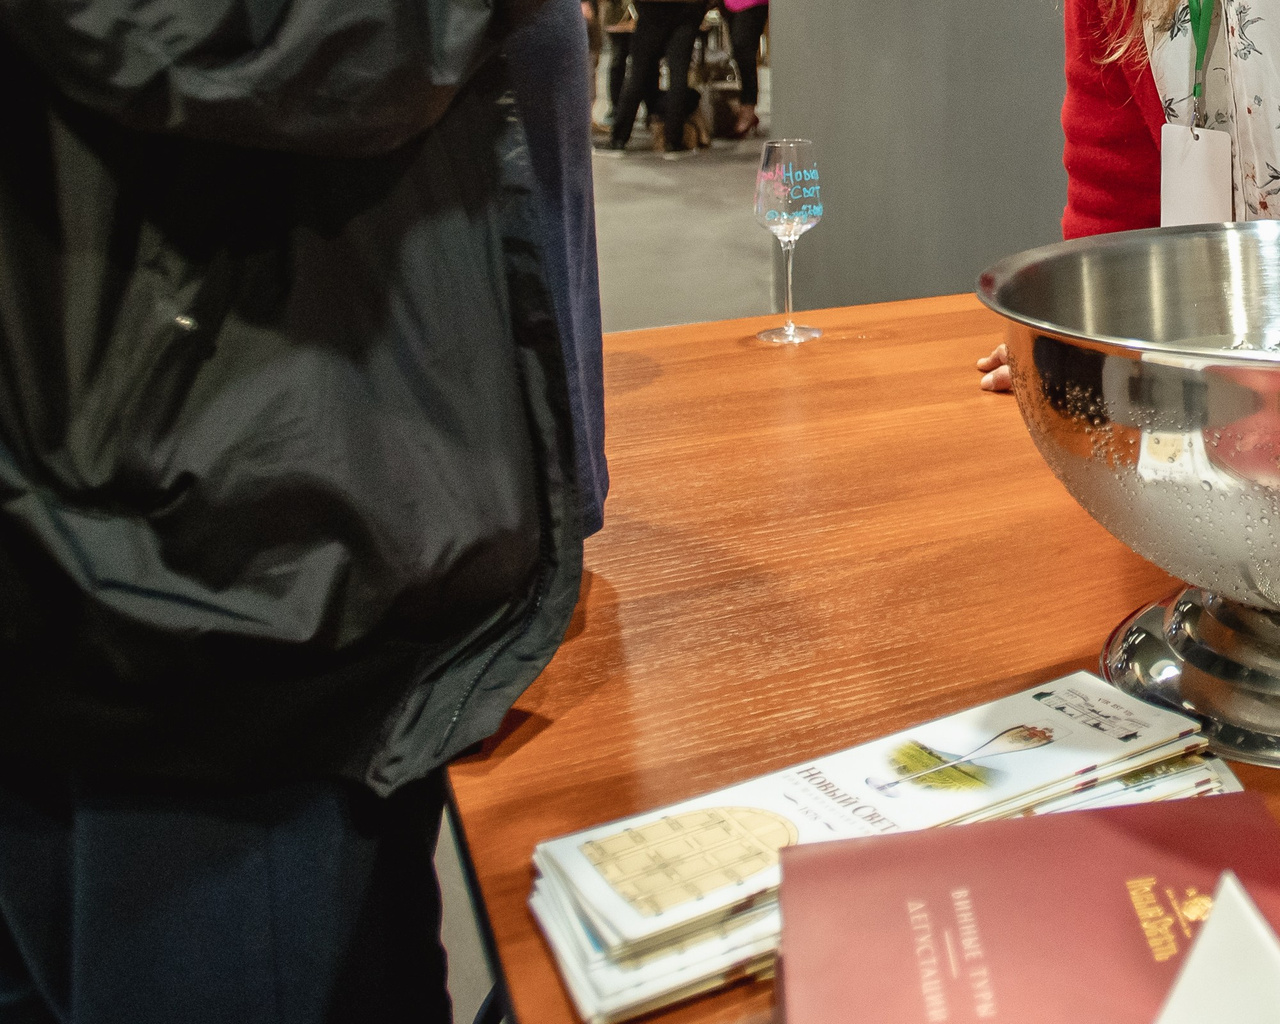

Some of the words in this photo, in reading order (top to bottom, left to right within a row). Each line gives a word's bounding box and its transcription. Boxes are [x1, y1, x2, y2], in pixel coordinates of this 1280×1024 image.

[907, 901, 948, 1022] ДЕГУСТАЦИИ
[951, 890, 982, 959] ВИННЫЕ
[969, 966, 997, 1017] ТУРЫ
